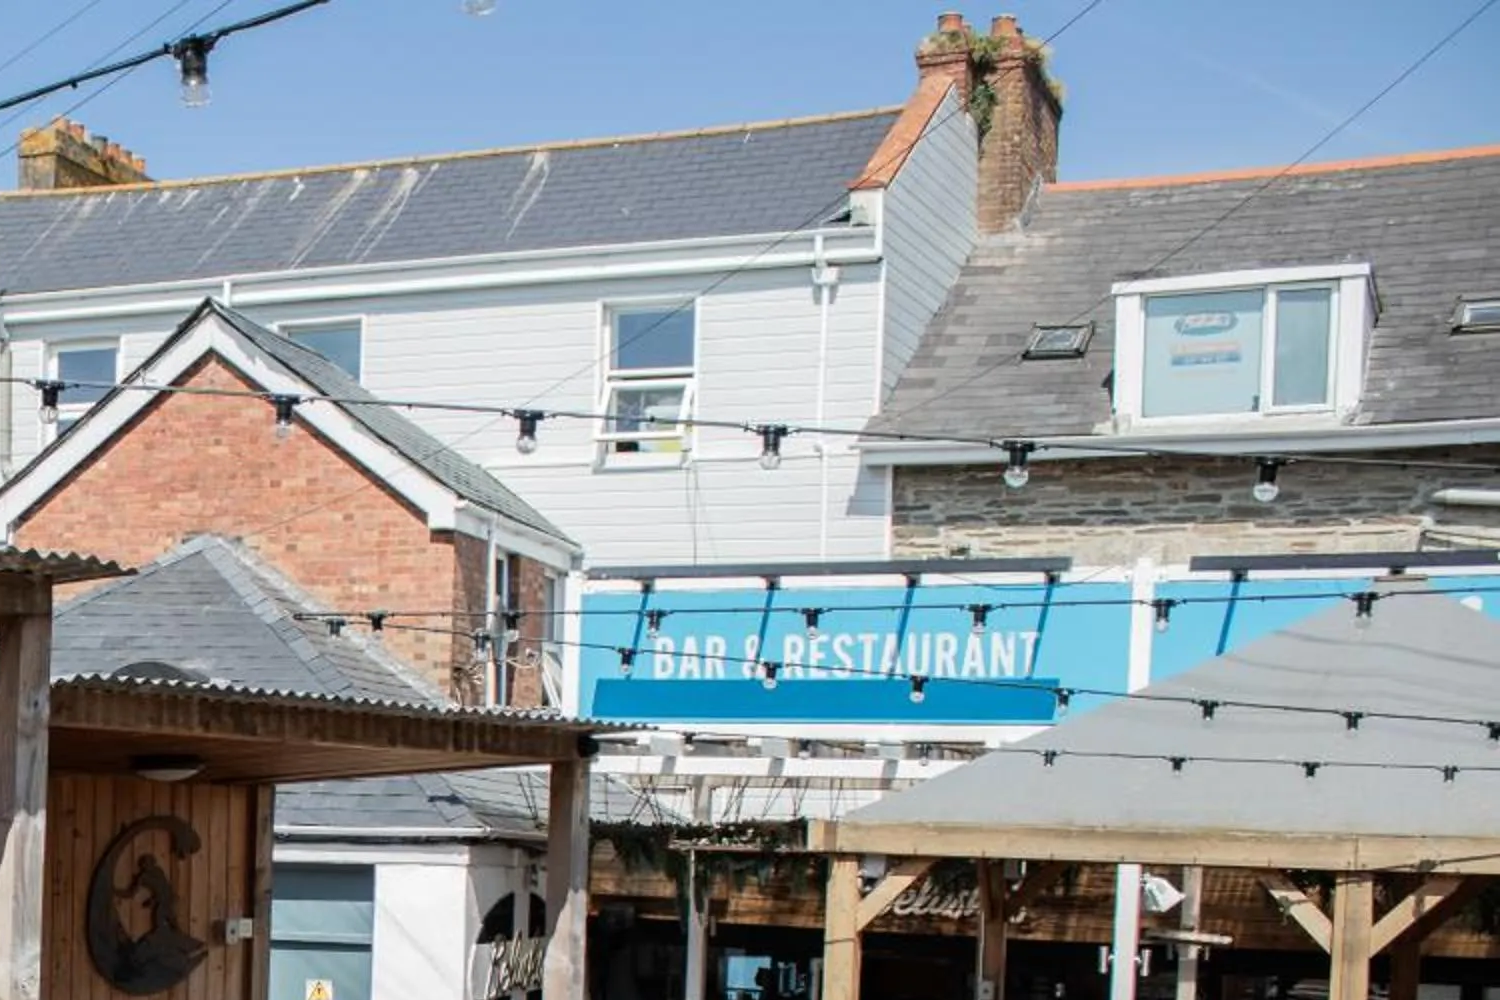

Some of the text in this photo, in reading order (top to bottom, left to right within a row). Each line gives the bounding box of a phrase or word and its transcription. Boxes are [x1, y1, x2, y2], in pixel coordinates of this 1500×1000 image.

[654, 631, 1041, 680] BAR & RESTAURANT
